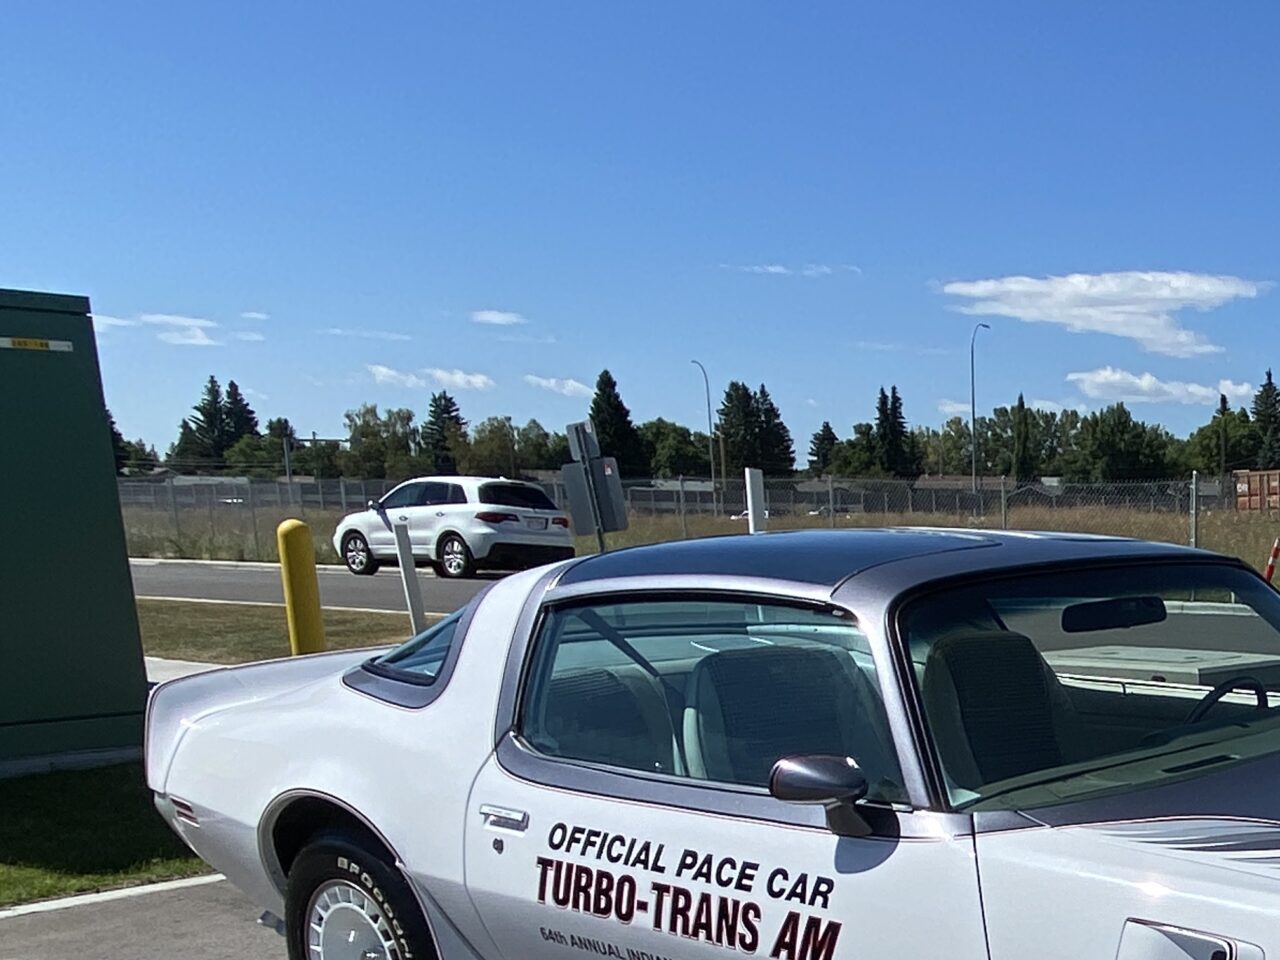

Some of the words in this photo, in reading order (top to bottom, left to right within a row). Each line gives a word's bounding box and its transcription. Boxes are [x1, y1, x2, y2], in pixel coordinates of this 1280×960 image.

[536, 856, 761, 955] TURBO-TRANS
[548, 823, 666, 874] OFFICIAL
[676, 849, 760, 893] PACE
[767, 868, 835, 909] CAR
[540, 927, 568, 946] 64th
[570, 934, 626, 960] ANNUAL
